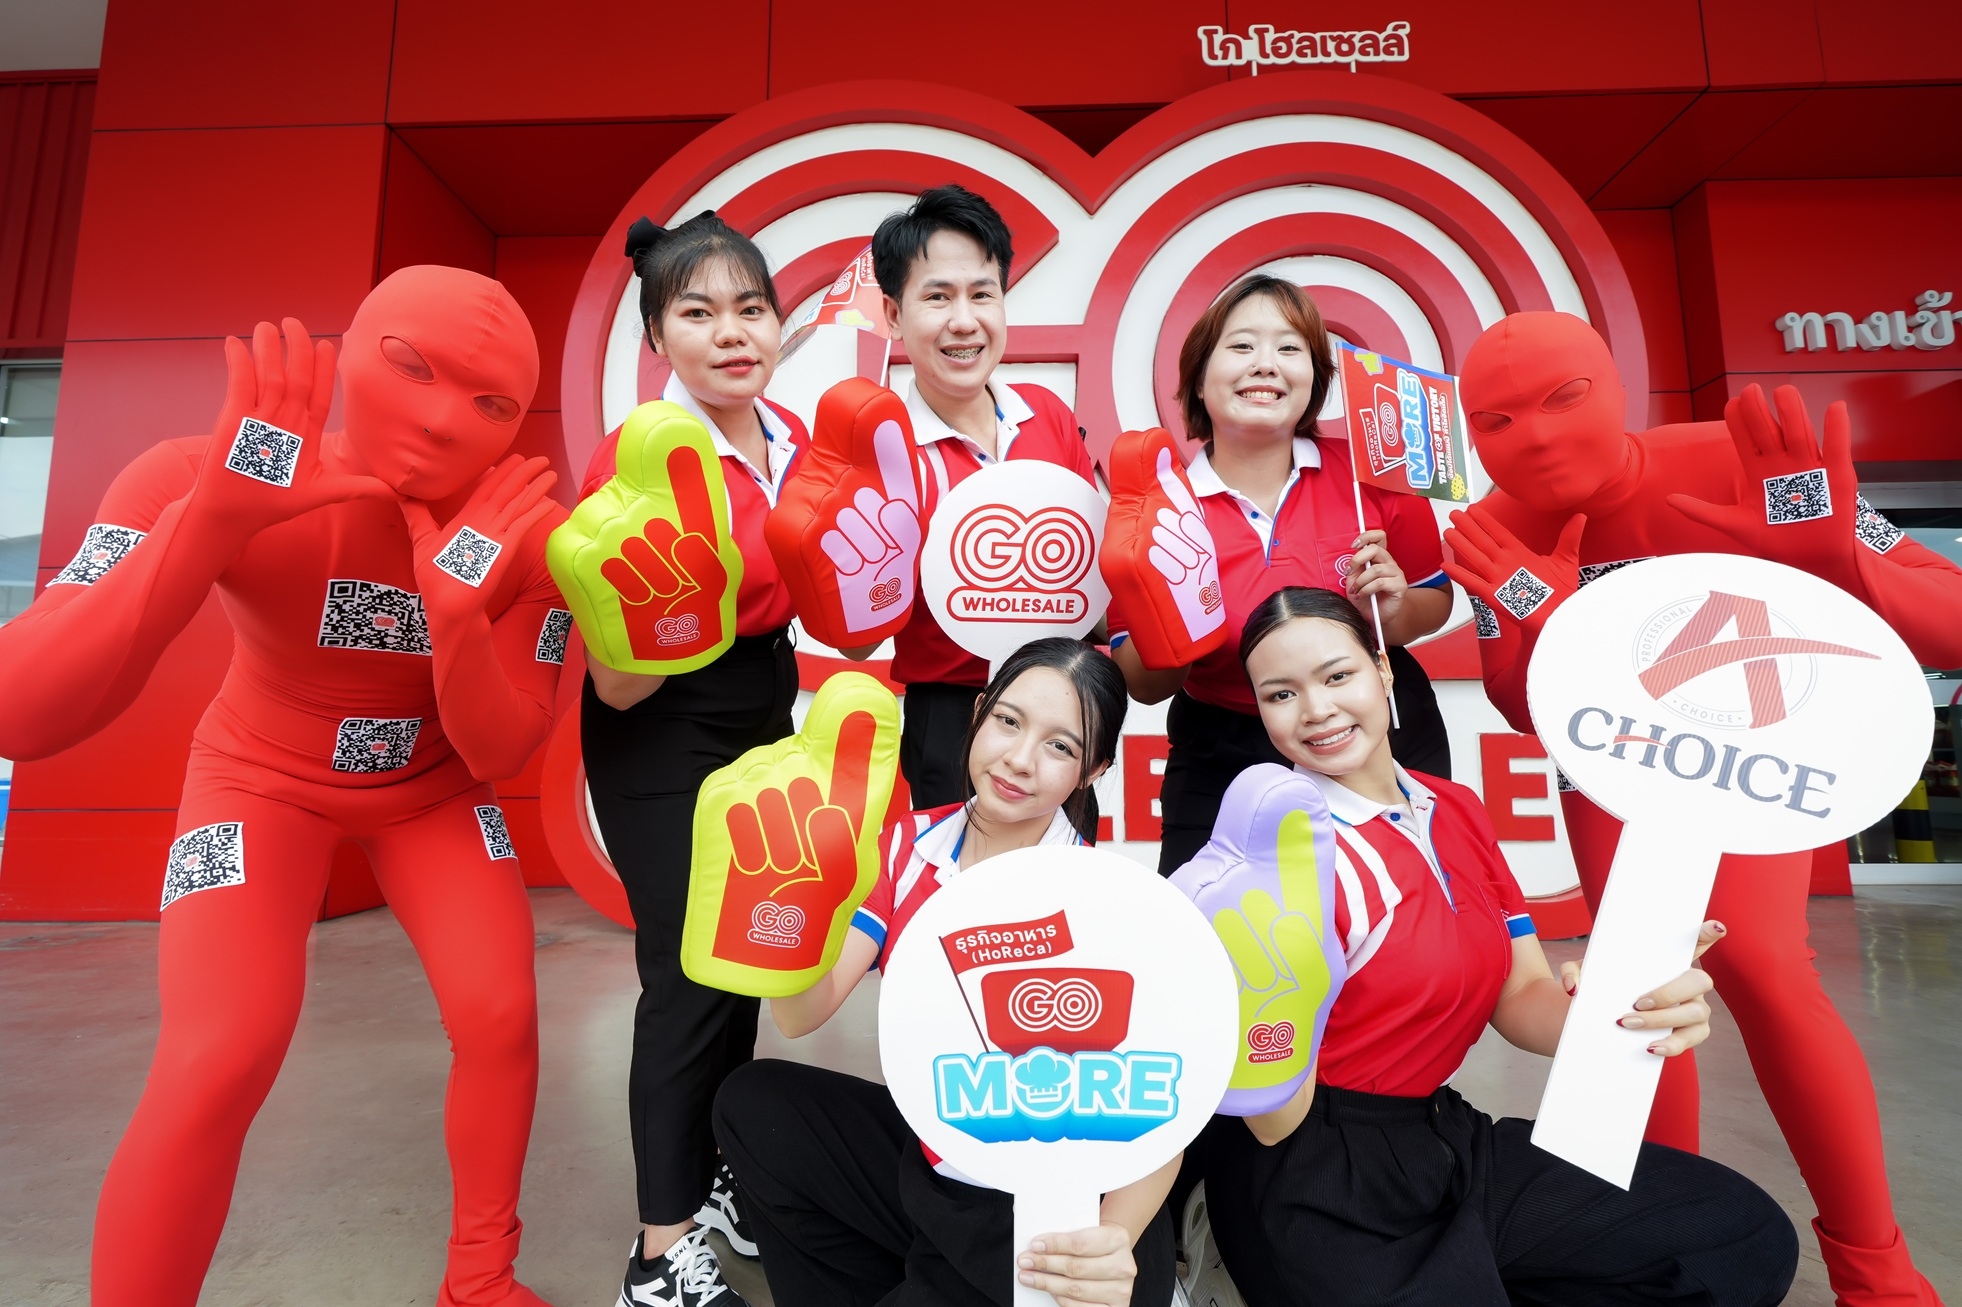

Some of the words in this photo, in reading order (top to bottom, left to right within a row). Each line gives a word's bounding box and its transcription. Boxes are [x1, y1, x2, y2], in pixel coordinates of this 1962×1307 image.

[1202, 27, 1244, 61] โก
[1253, 23, 1408, 60] โฮลเซลล์
[1776, 290, 1962, 351] ทางเข้
[1380, 402, 1399, 446] GO
[1428, 385, 1442, 432] VICTORY
[1436, 450, 1447, 485] TASTE
[950, 503, 1095, 594] GO
[869, 577, 902, 603] GO
[962, 596, 1076, 614] WHOLESALE
[655, 613, 699, 639] GO
[661, 633, 697, 644] WHOLESALE
[1641, 605, 1693, 663] PROFESSIONAL
[1681, 703, 1734, 723] CHOICE
[1568, 707, 1837, 818] CHOICE
[752, 901, 806, 936] GO
[753, 932, 796, 945] WHOLESALE
[955, 924, 1057, 953] ธุรกิจอาหาร
[971, 941, 1053, 964] (HoReCa)
[1008, 977, 1103, 1032] GO
[1247, 1020, 1295, 1052] GO
[1252, 1050, 1291, 1061] WHOLESALE
